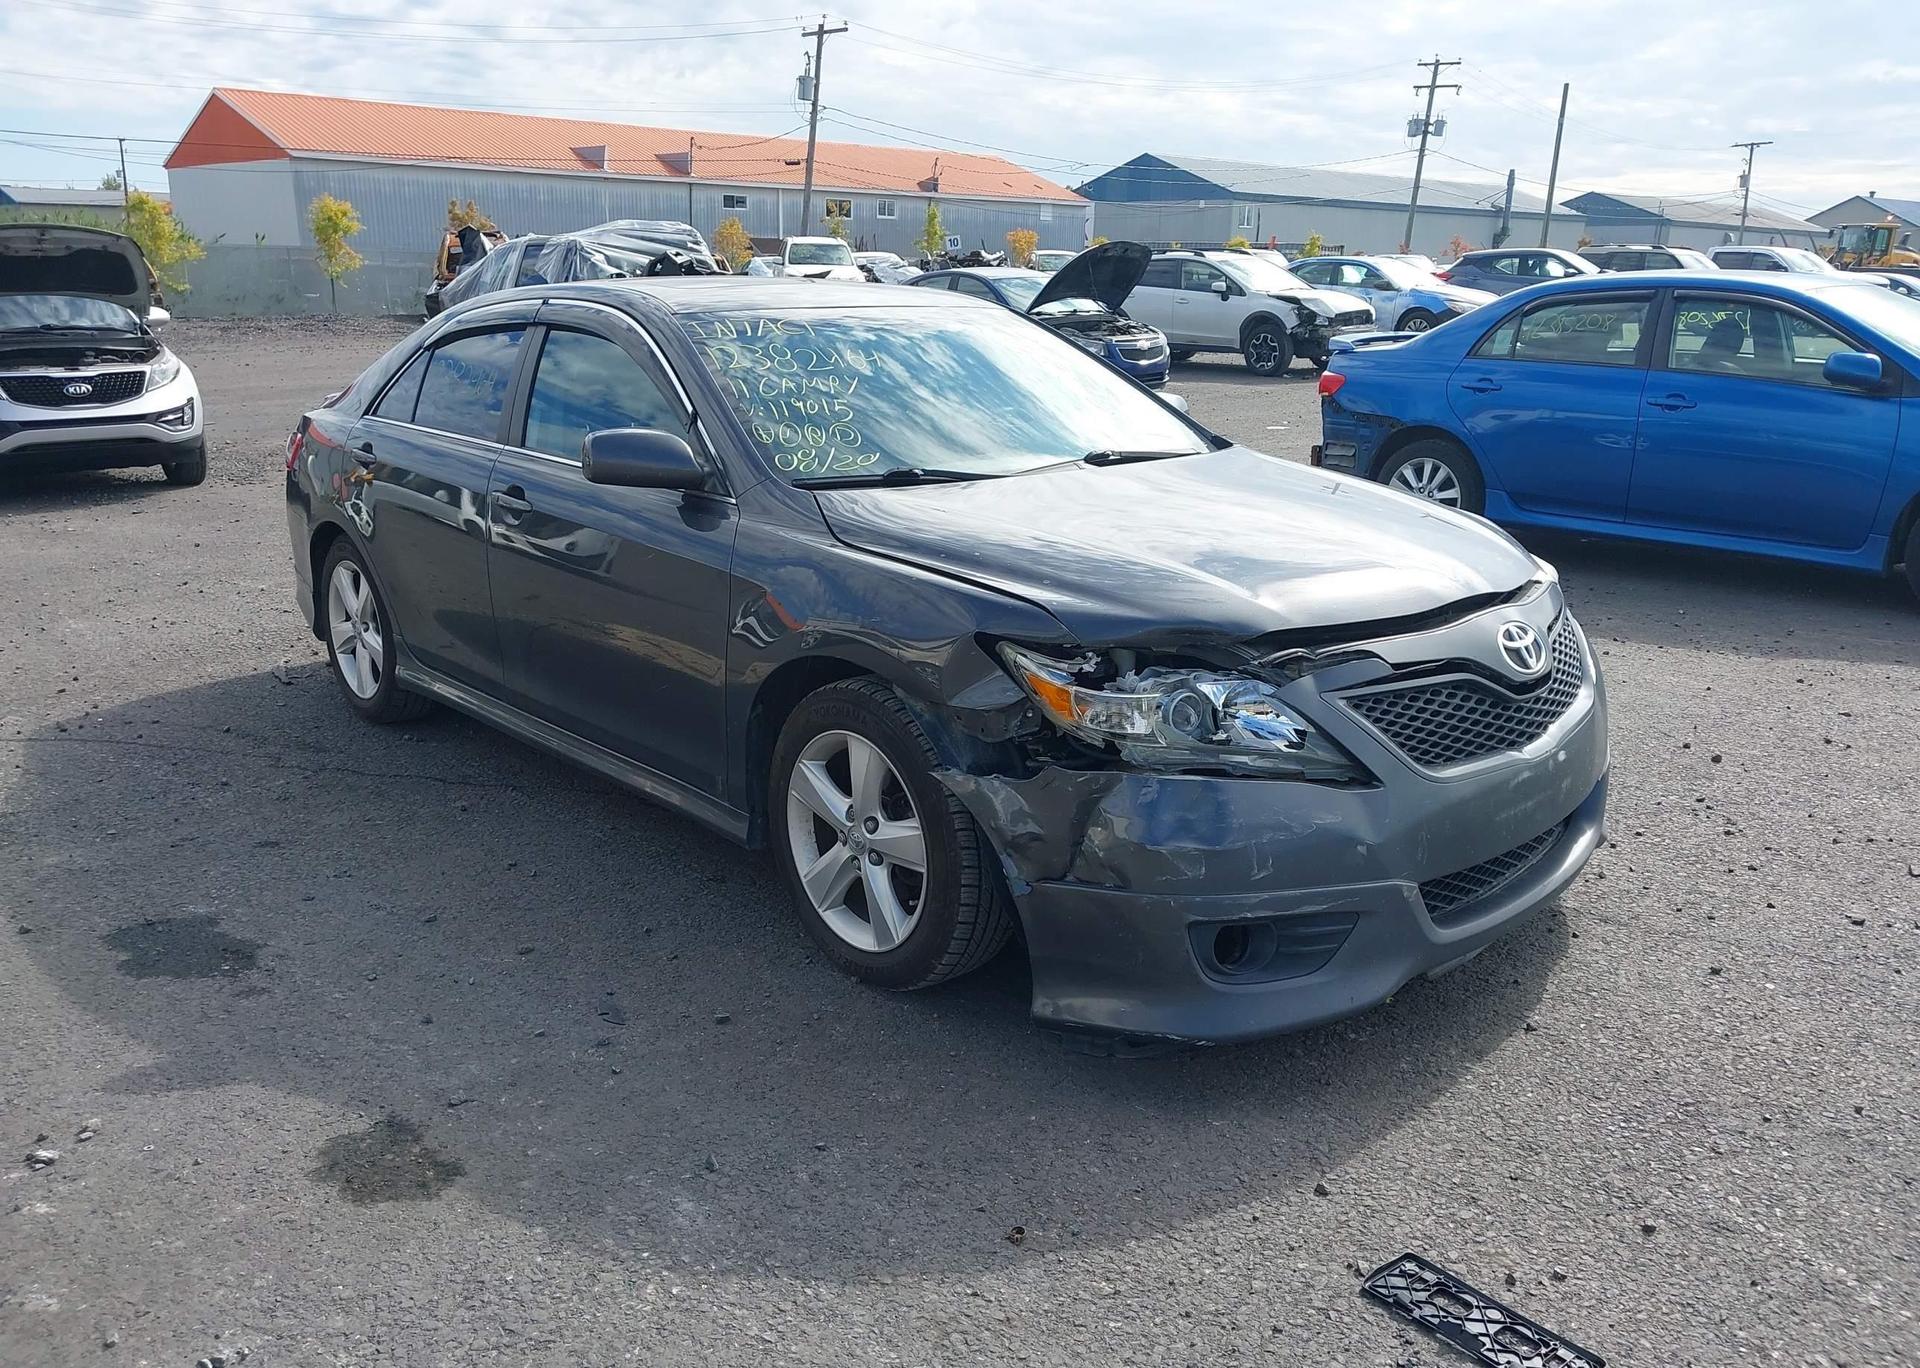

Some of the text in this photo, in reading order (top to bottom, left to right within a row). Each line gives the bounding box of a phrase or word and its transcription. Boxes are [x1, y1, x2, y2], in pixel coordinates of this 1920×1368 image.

[948, 237, 959, 248] 10
[704, 343, 882, 373] 12382464
[727, 374, 860, 399] 11 CAMRY
[774, 446, 882, 474] 08/20
